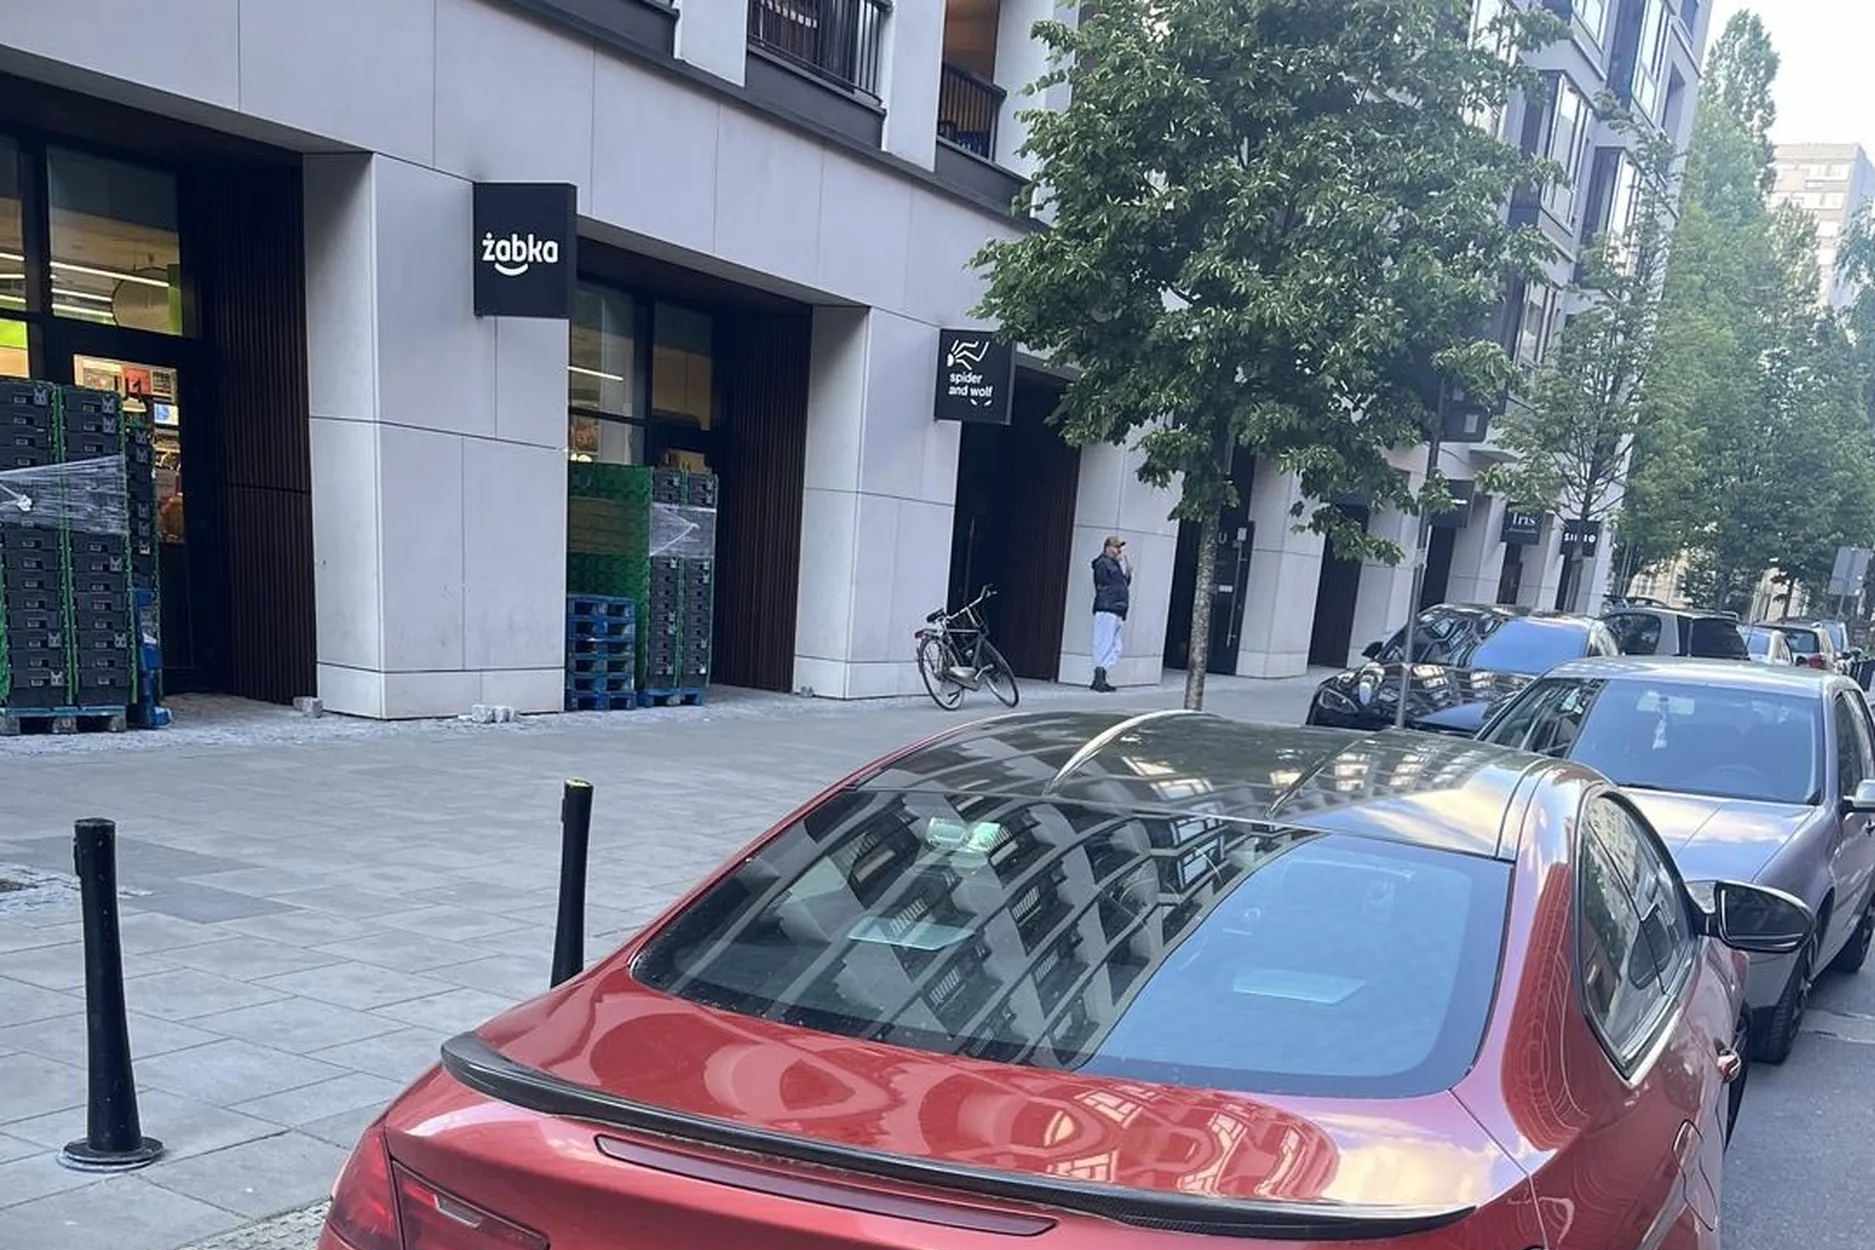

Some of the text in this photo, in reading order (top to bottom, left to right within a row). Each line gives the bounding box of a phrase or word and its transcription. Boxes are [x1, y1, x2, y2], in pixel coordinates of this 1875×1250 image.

[481, 231, 559, 263] żabka
[949, 371, 983, 385] spider
[948, 385, 994, 397] and wolf
